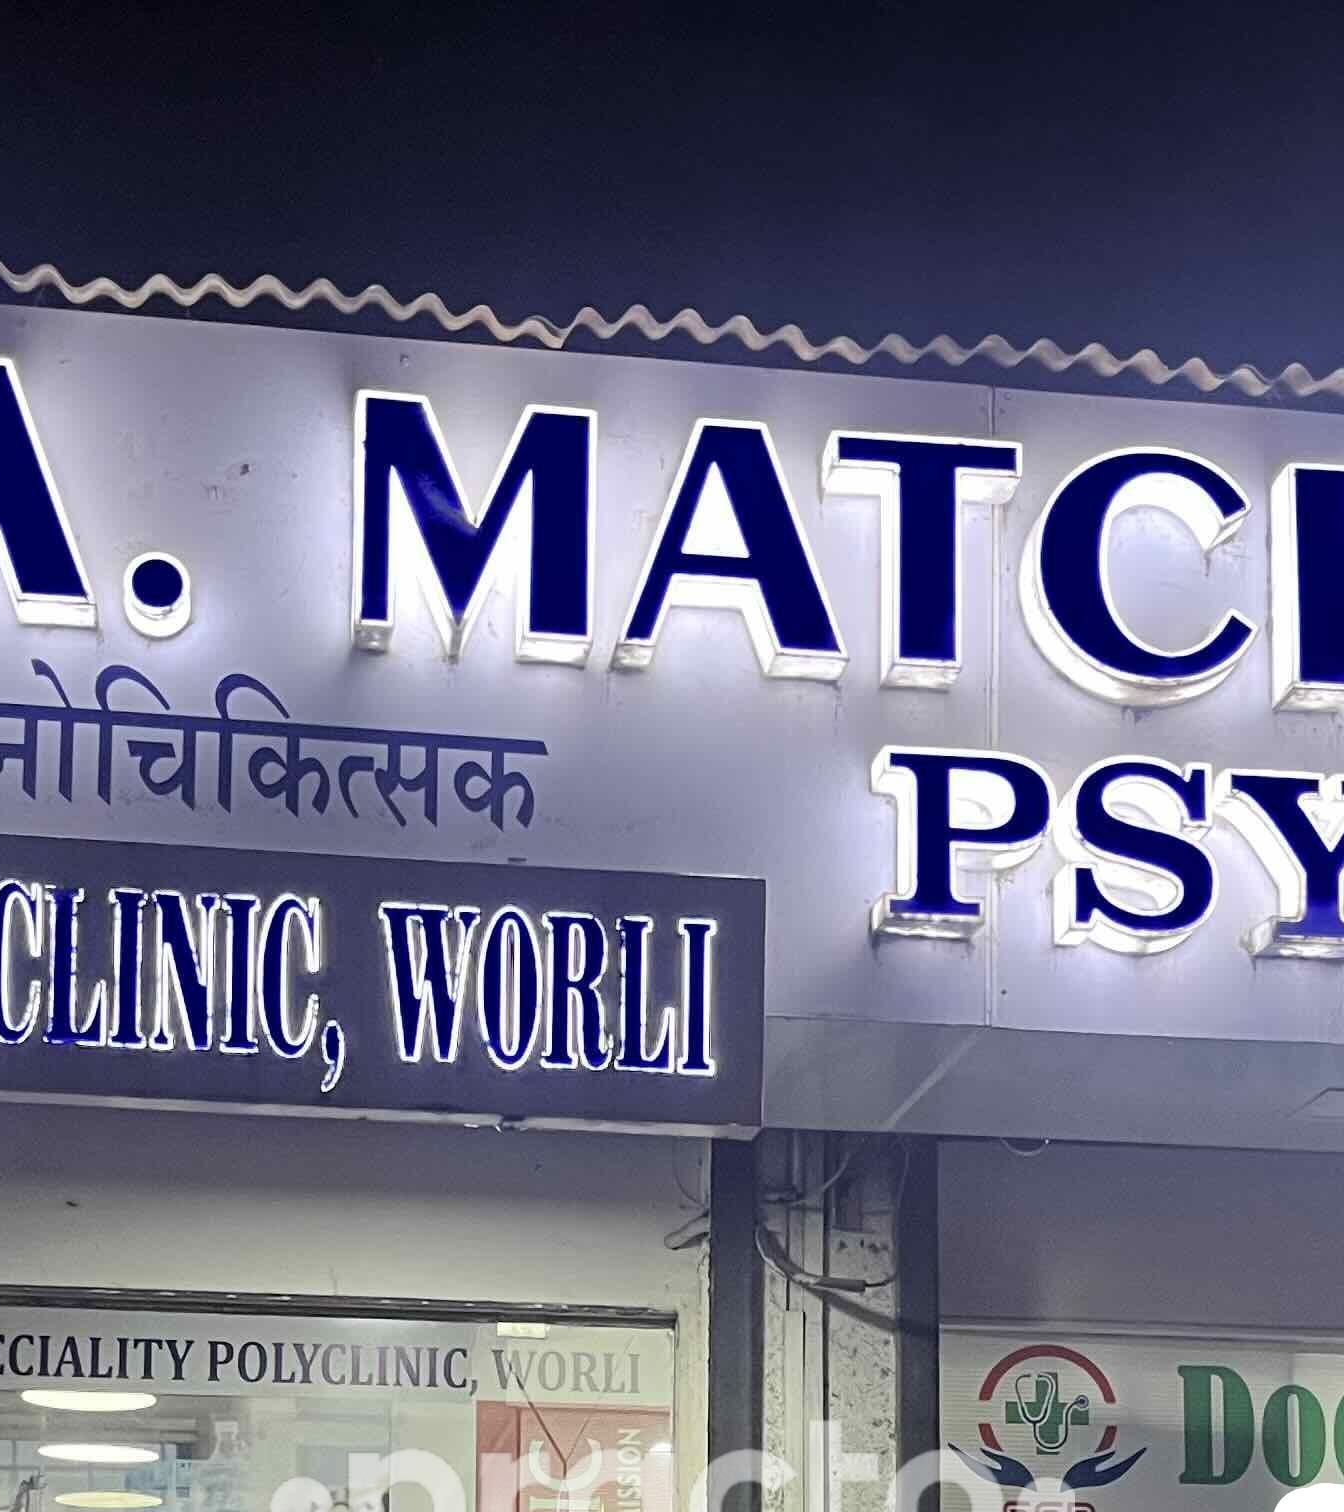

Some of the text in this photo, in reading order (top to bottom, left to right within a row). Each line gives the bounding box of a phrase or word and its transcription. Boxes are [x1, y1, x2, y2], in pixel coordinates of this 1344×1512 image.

[380, 901, 718, 1078] WORLI
[208, 1339, 481, 1394] POLYCLINIC,
[494, 1347, 642, 1394] WORLI
